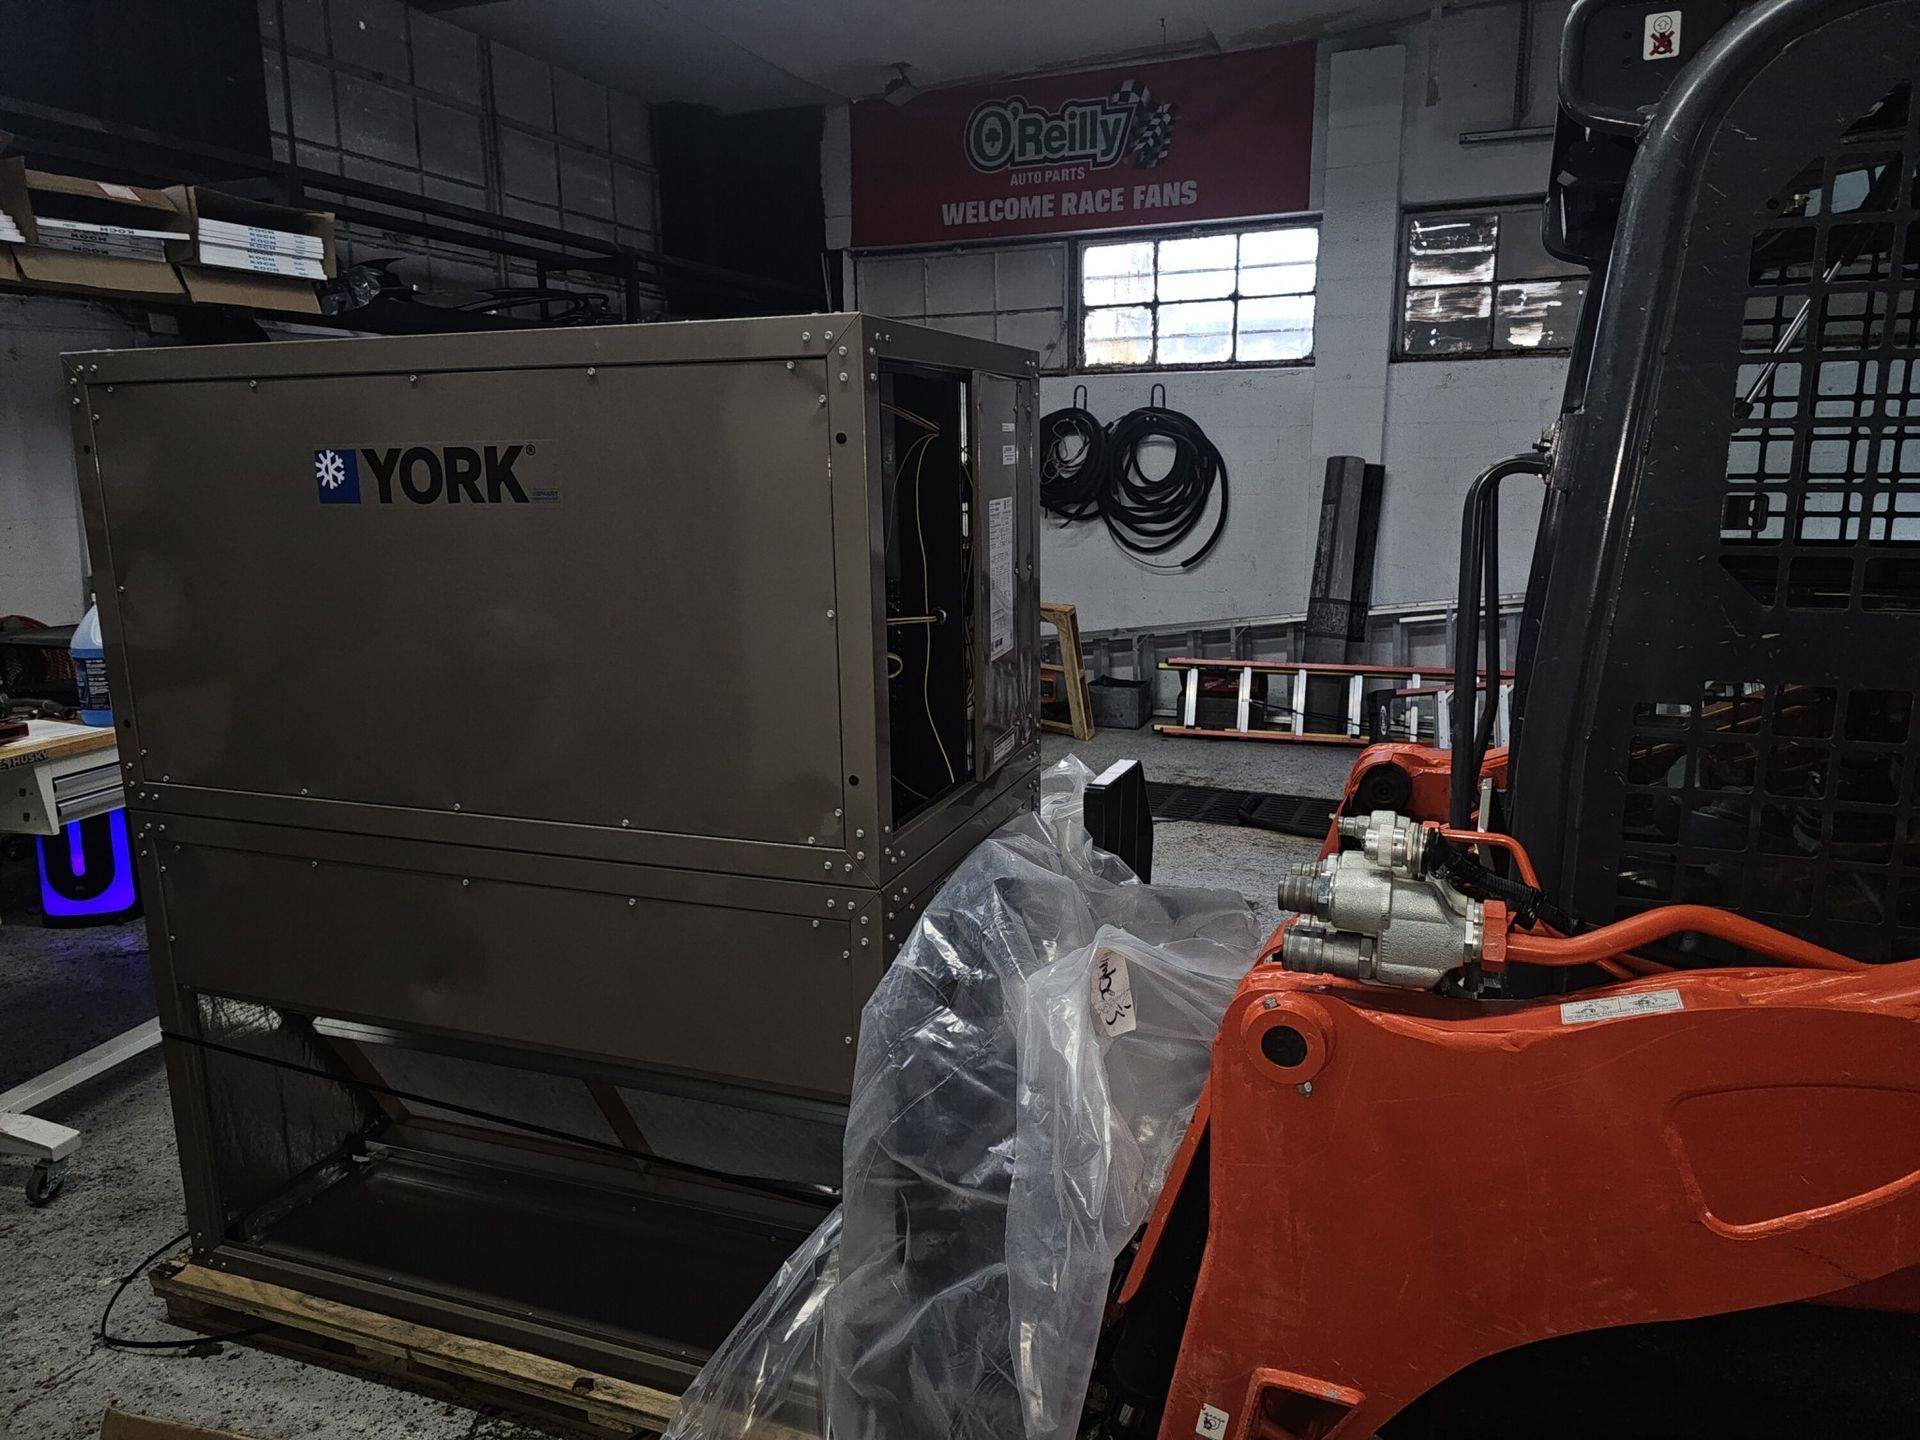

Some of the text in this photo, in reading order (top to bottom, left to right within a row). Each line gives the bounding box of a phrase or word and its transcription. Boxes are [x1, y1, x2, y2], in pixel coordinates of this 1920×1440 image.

[970, 100, 1134, 165] O'Reilly
[1010, 167, 1085, 186] AUTO PARTS
[942, 180, 1197, 226] WELCOME RACE FANS
[361, 445, 530, 504] YORK
[13, 749, 48, 767] HUSKY
